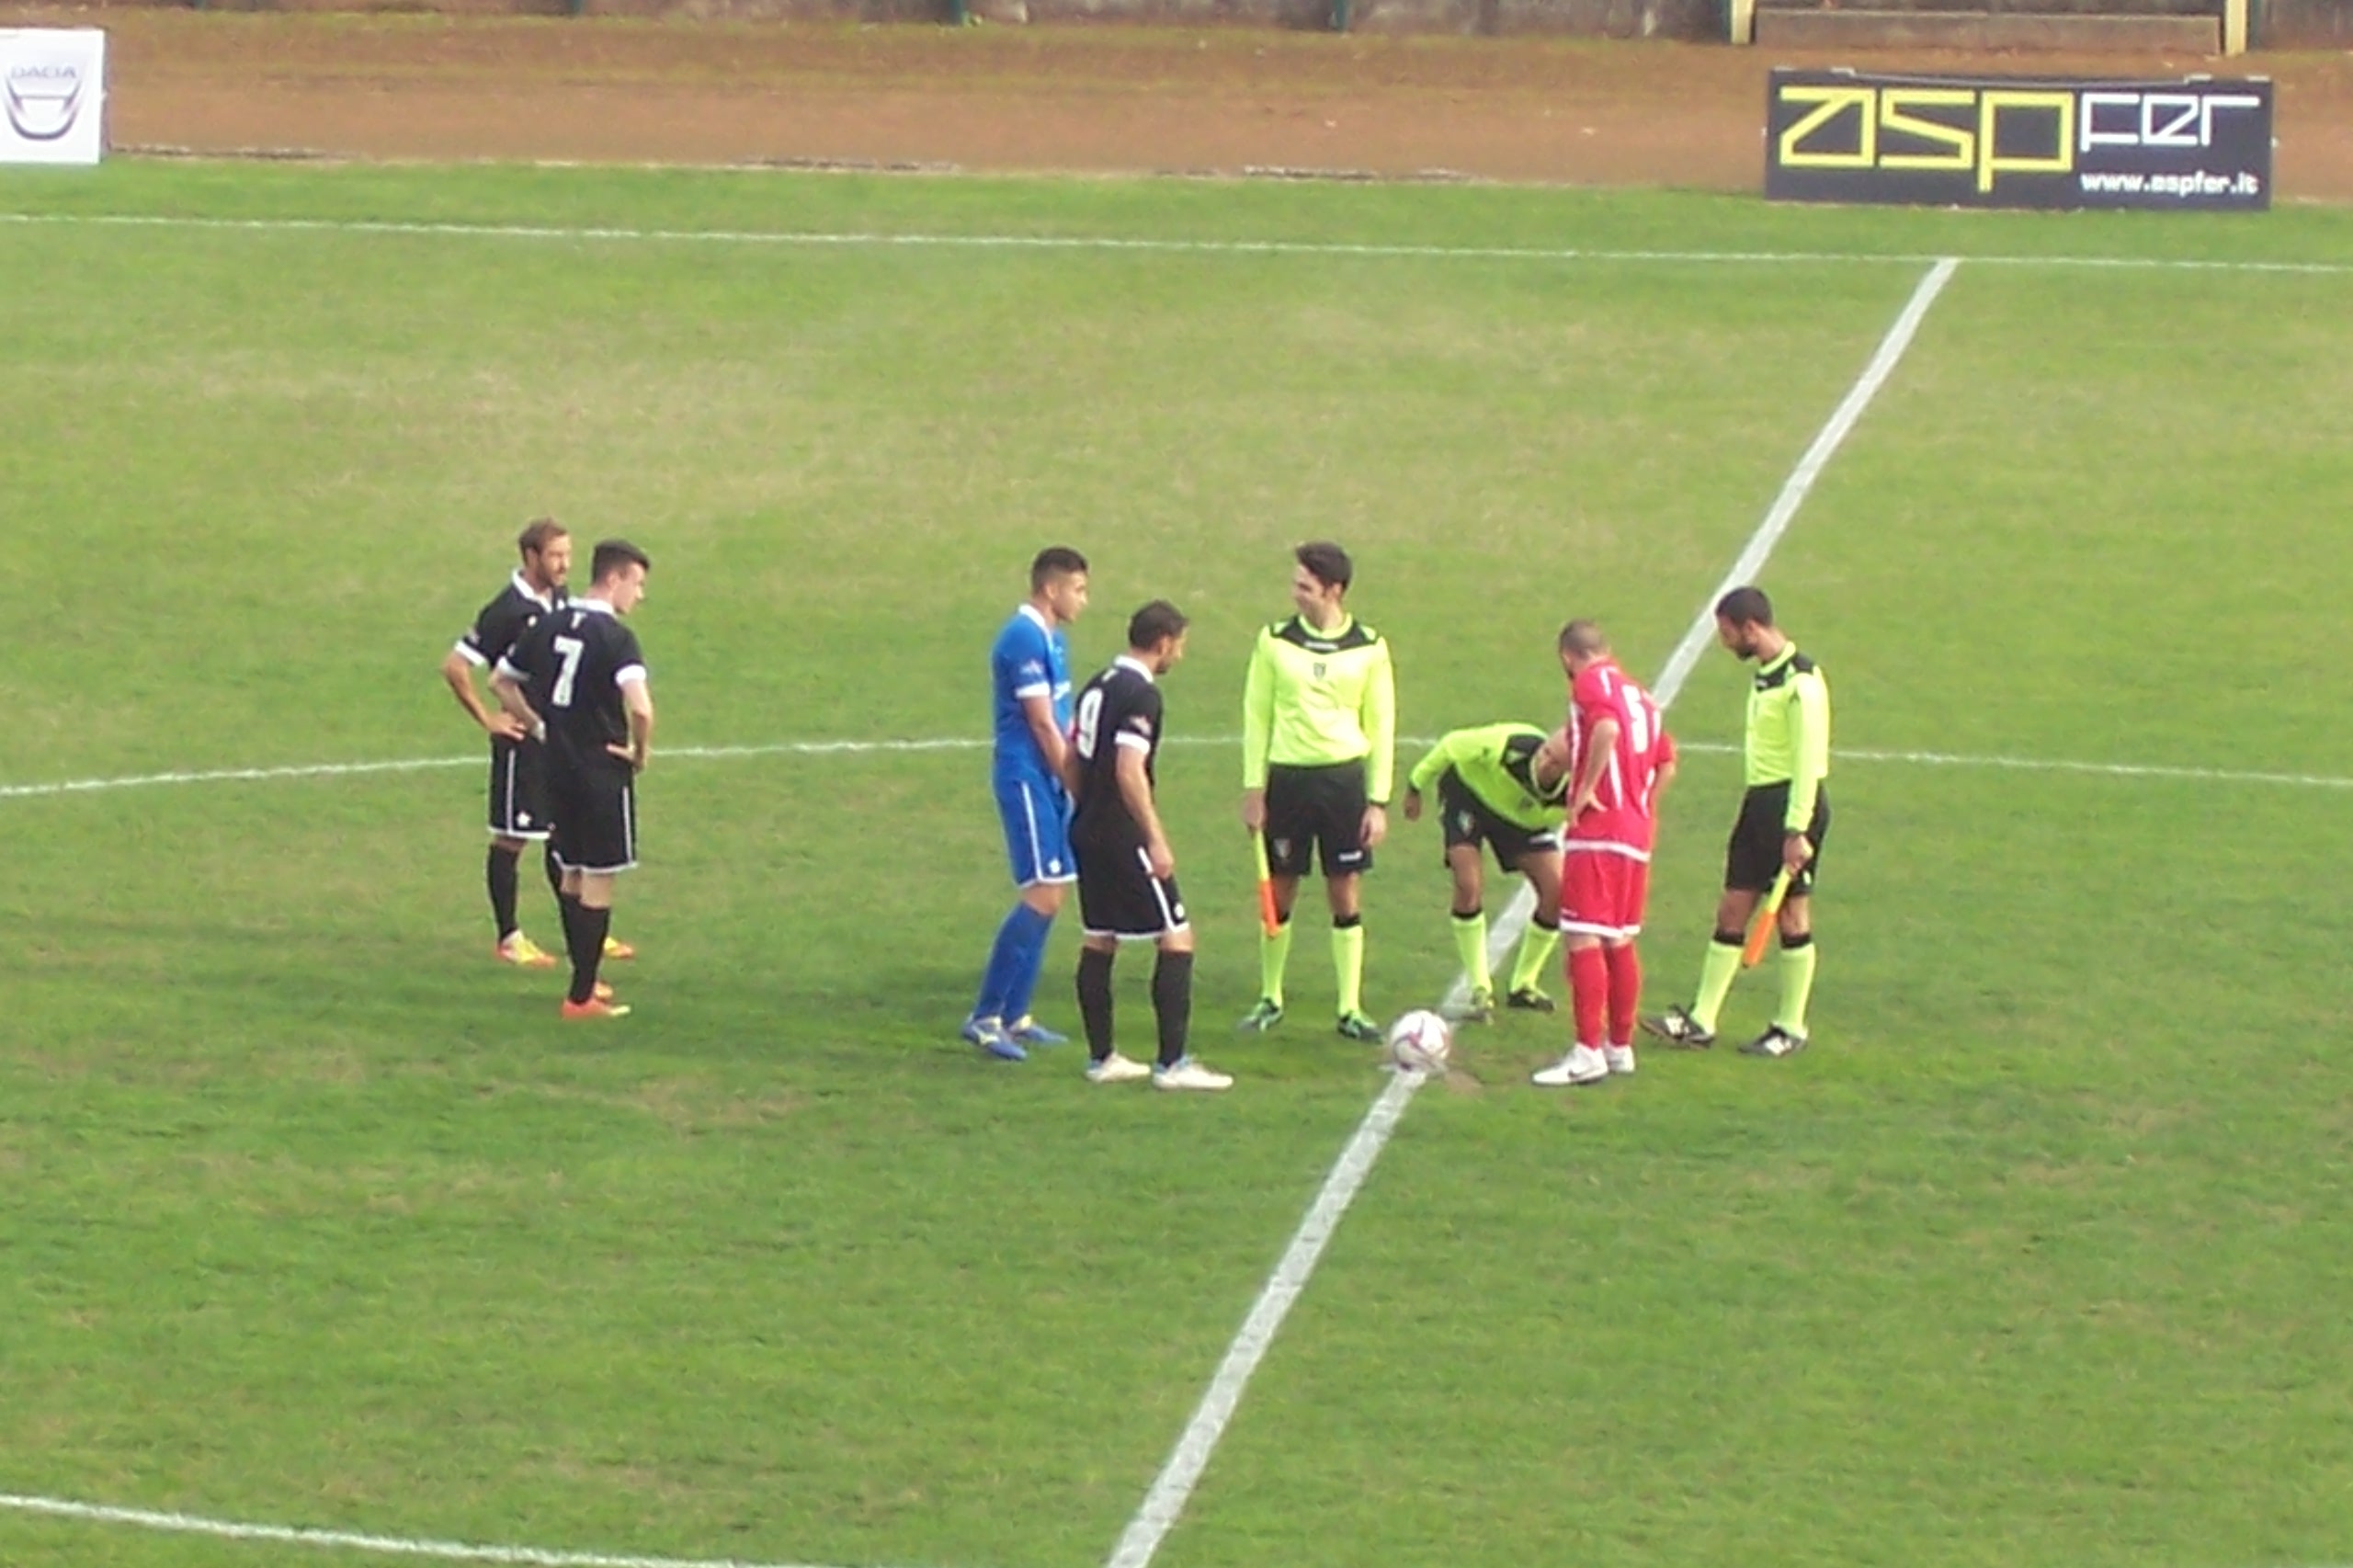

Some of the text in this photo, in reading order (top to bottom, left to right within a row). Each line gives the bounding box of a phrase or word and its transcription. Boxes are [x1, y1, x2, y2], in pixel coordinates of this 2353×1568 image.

[10, 64, 77, 79] DACIA
[2080, 170, 2259, 198] www.aspfer.it
[551, 634, 585, 707] 7
[1077, 687, 1104, 758] 9
